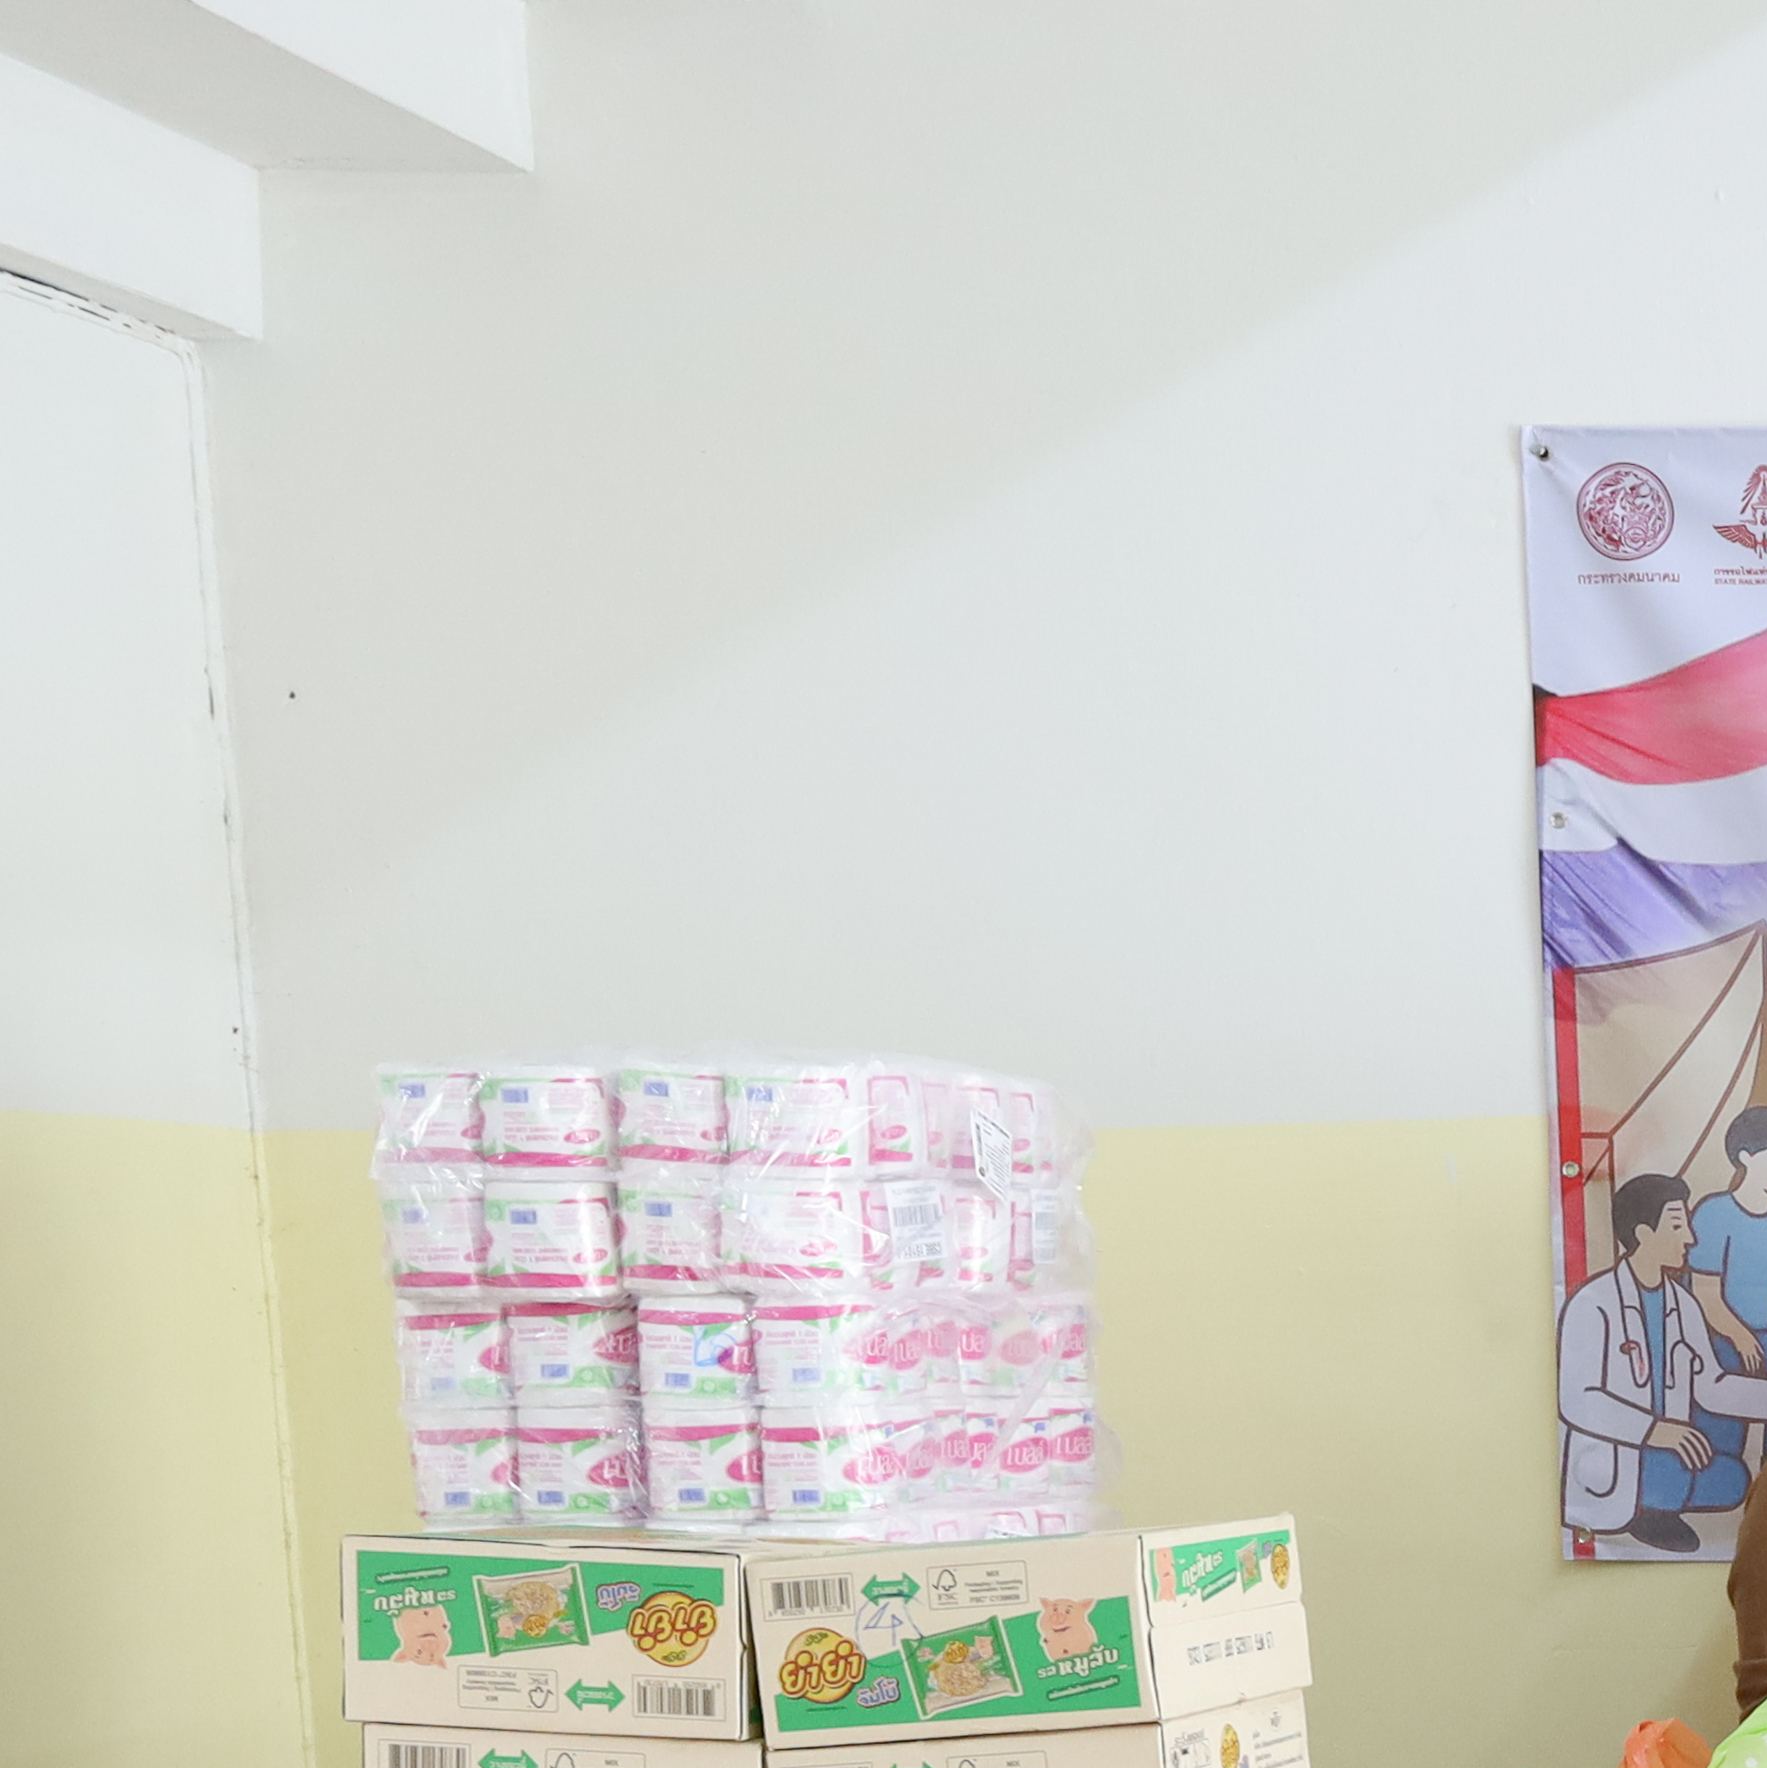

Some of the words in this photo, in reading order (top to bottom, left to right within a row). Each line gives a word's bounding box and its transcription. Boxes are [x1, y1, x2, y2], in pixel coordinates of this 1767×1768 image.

[1577, 571, 1681, 585] กระทรวงคมนาคม
[780, 1642, 867, 1698] ยำยำ
